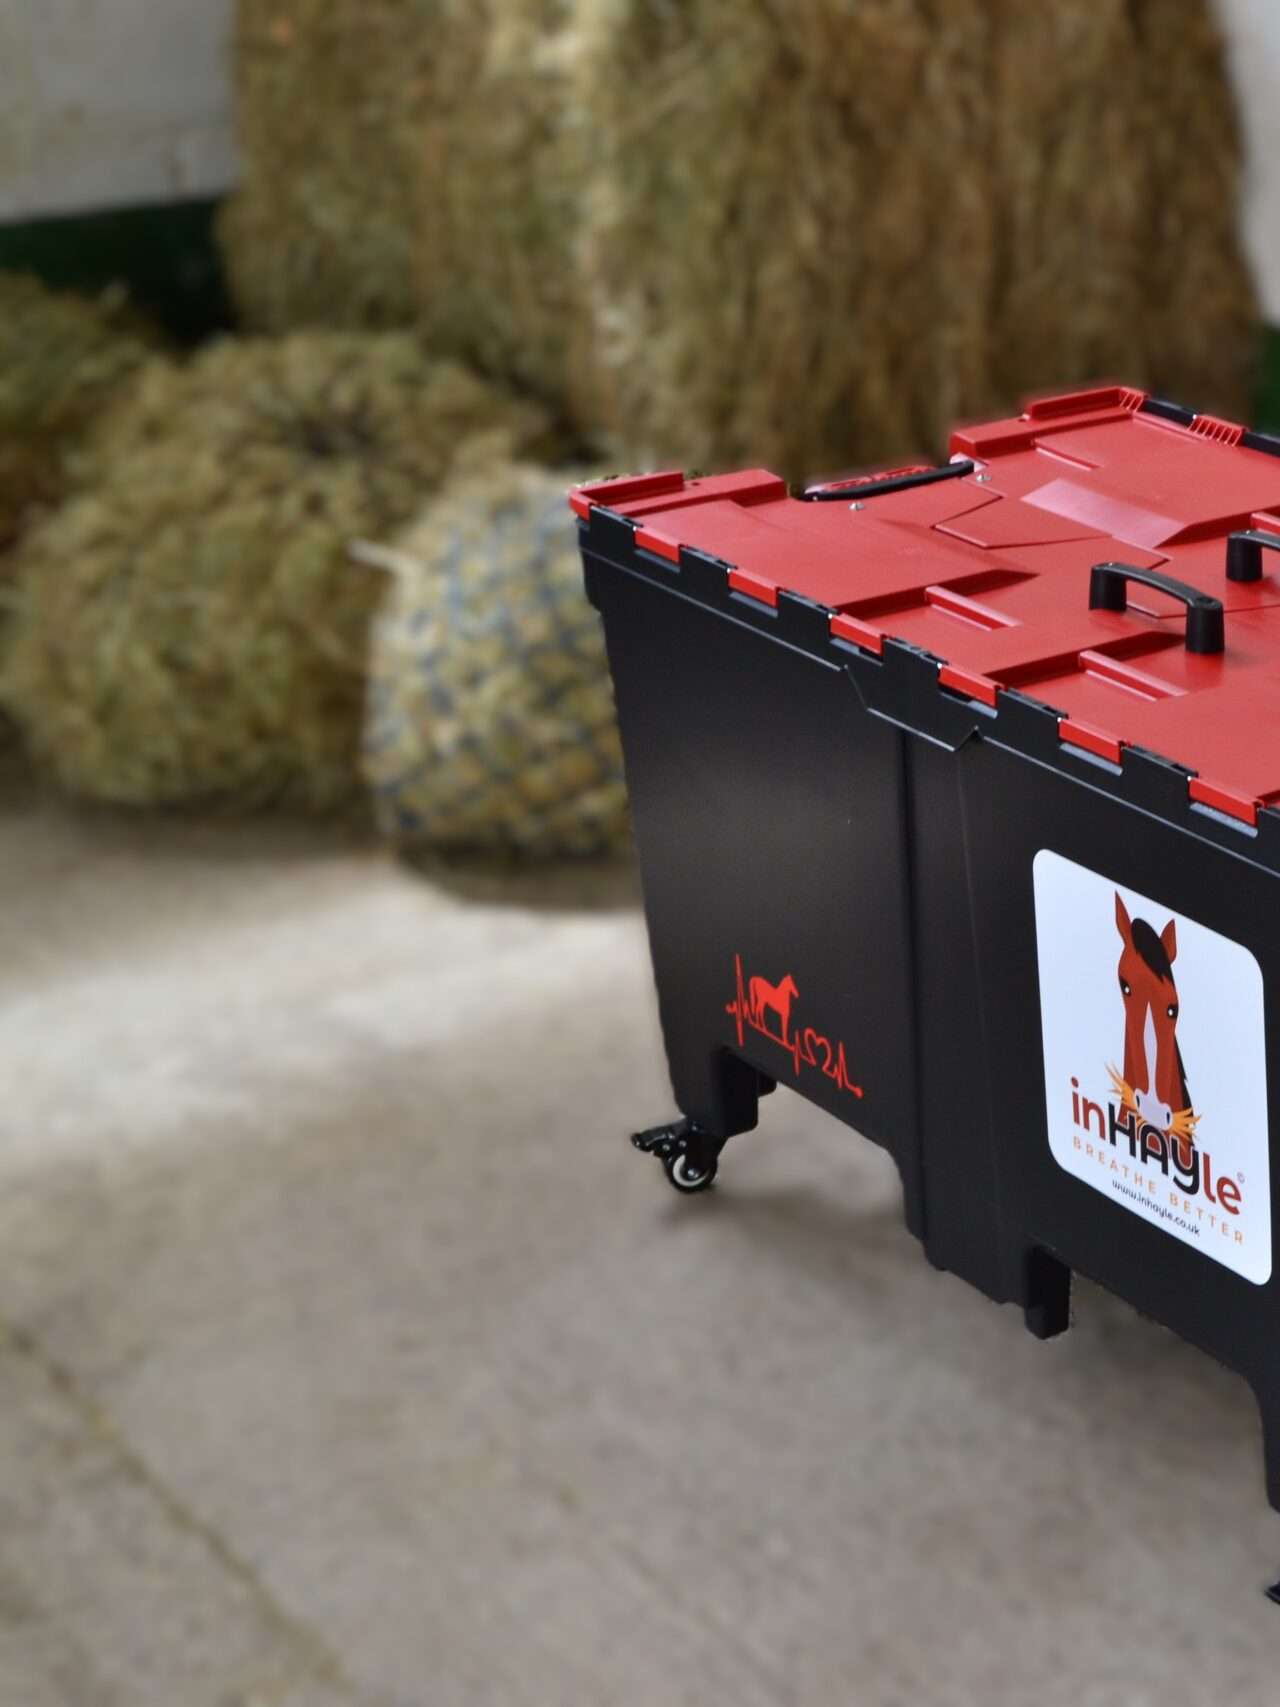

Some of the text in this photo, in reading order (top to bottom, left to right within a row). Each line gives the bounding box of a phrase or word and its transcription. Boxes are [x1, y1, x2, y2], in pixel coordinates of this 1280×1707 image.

[1073, 1135, 1244, 1244] BREATHE BETTER
[1111, 1178, 1201, 1237] www.inhayle.co.uk
